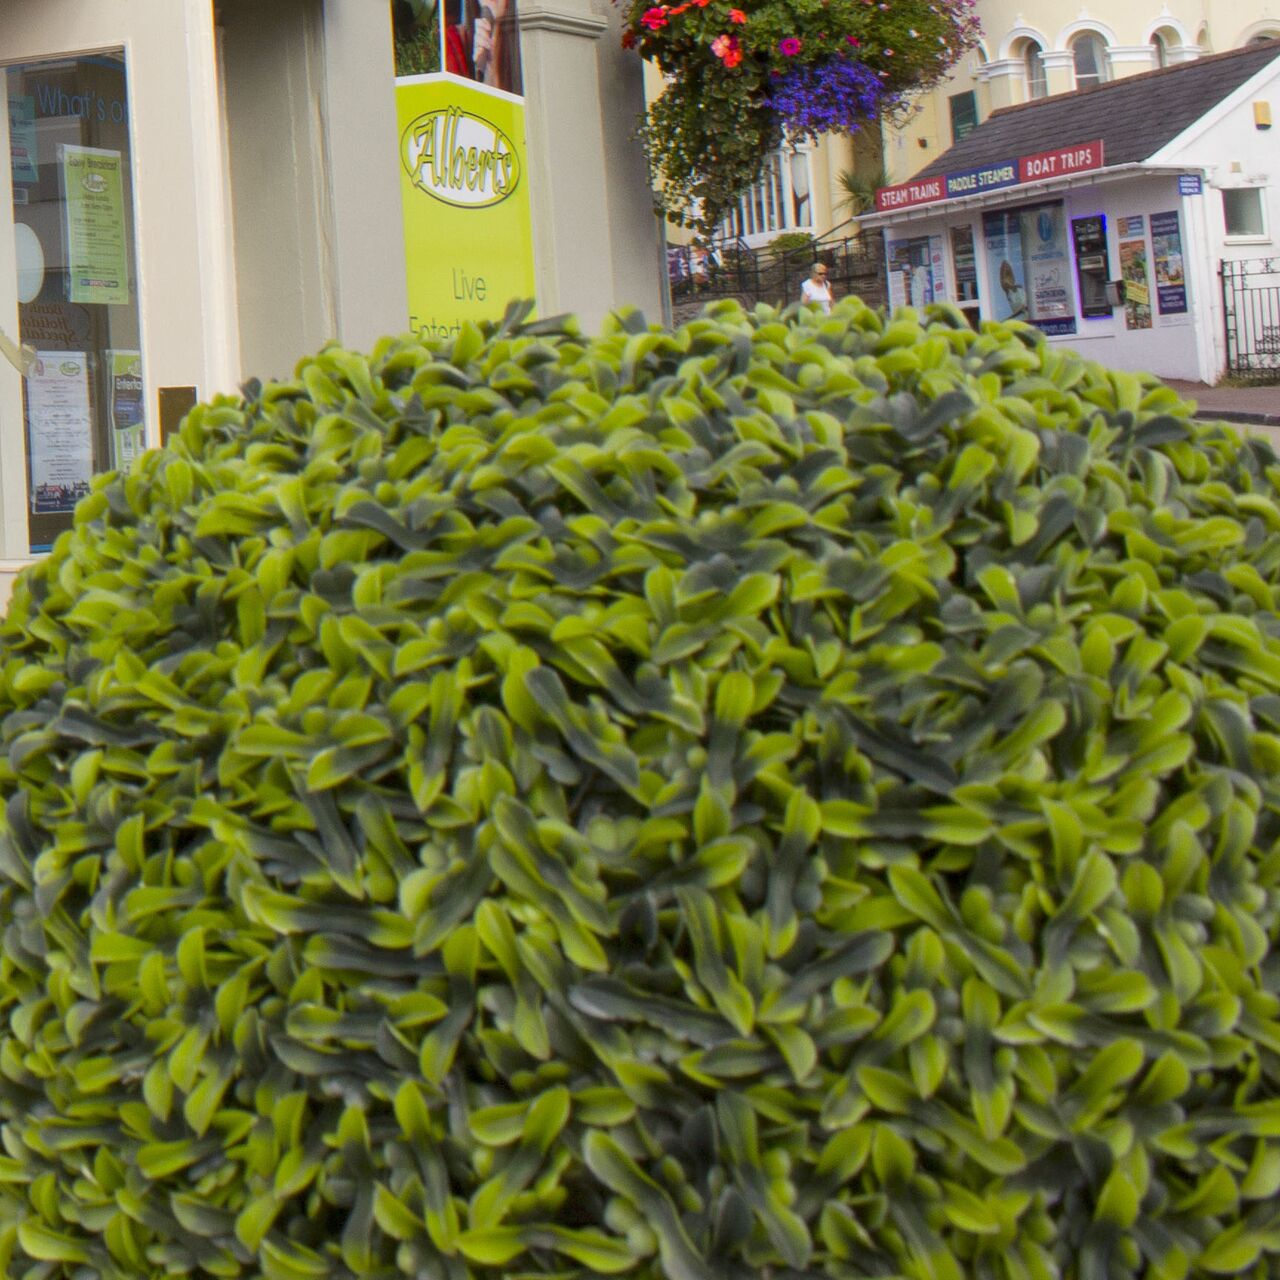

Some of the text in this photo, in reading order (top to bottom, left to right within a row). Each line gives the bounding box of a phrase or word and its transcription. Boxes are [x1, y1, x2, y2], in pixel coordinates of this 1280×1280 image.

[411, 104, 512, 197] Alberts
[1026, 148, 1093, 177] BOAT TRIPS
[947, 166, 1015, 193] PADDLE STEAMER
[881, 182, 941, 207] STEAM TRAINS
[452, 267, 487, 302] Live
